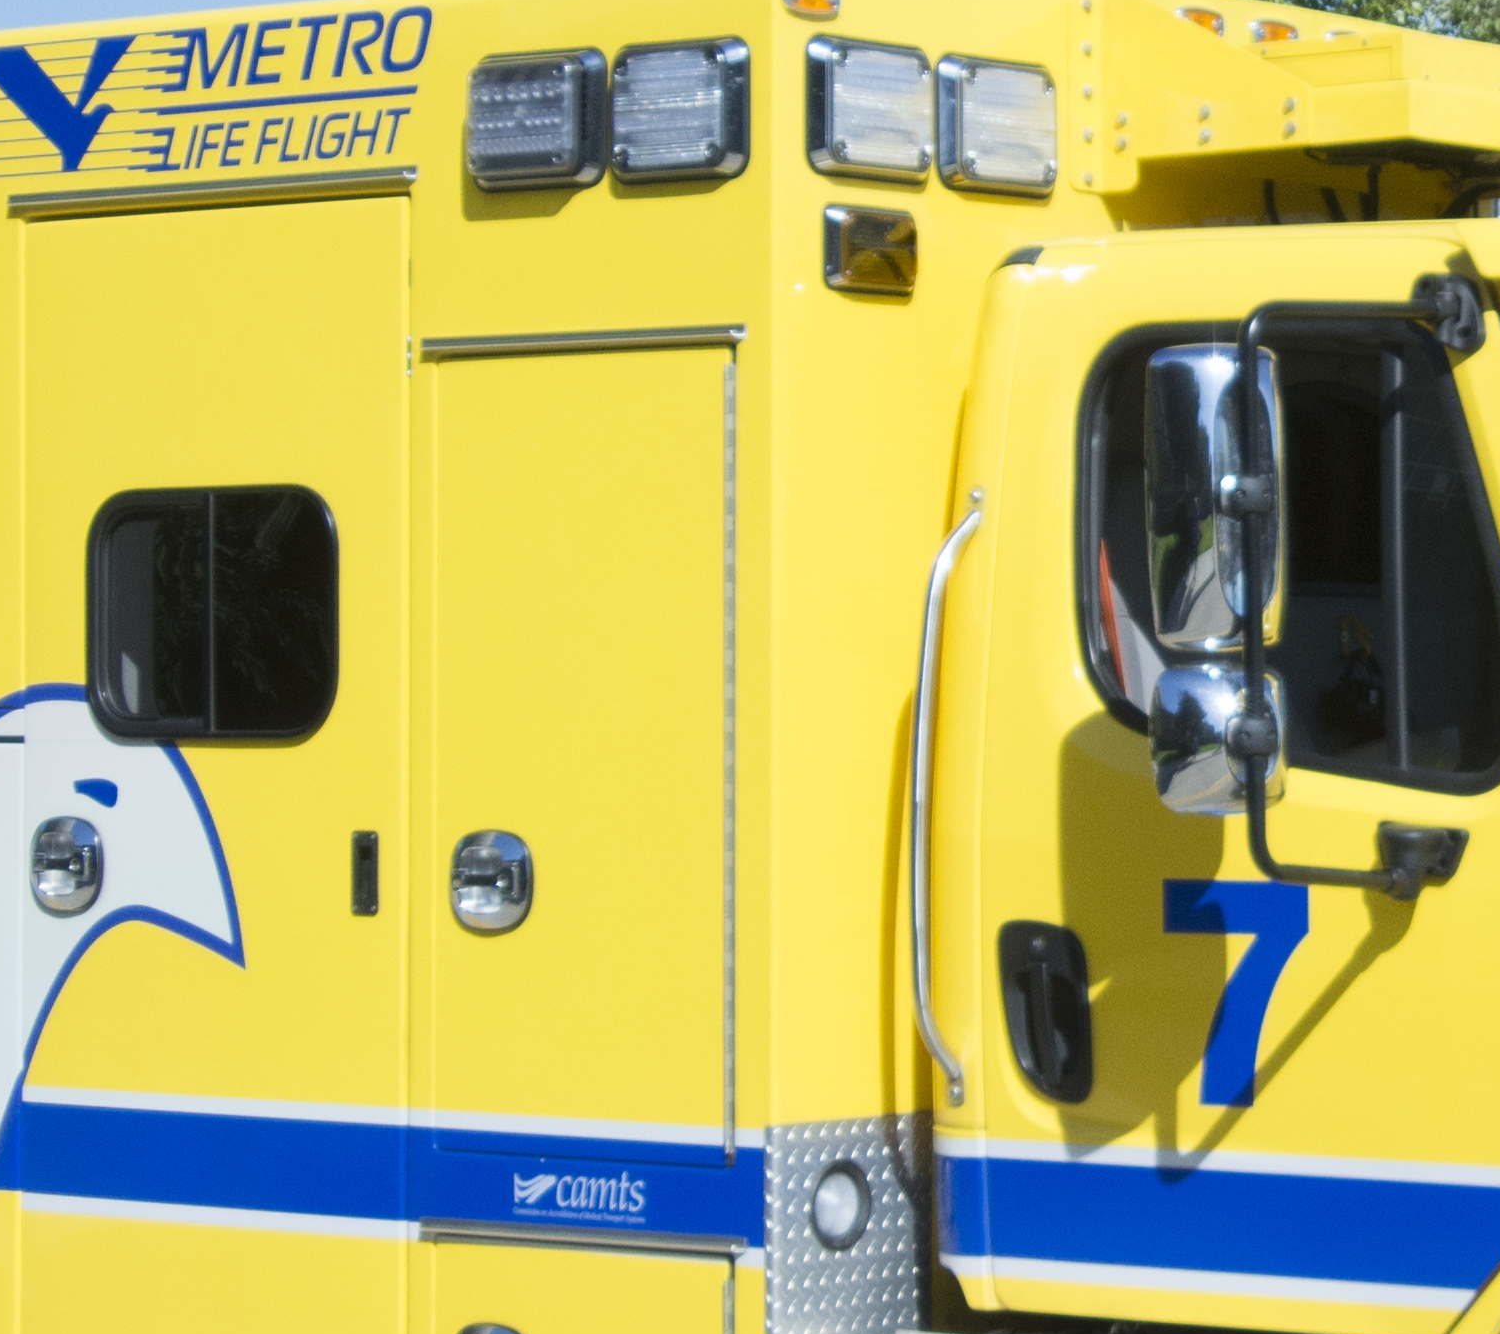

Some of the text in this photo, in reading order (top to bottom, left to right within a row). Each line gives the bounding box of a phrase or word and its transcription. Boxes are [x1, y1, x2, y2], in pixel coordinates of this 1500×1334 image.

[155, 6, 432, 92] METRO
[145, 107, 412, 172] LIFE FLIGHT
[1163, 879, 1310, 1107] 7
[556, 1170, 646, 1212] camts
